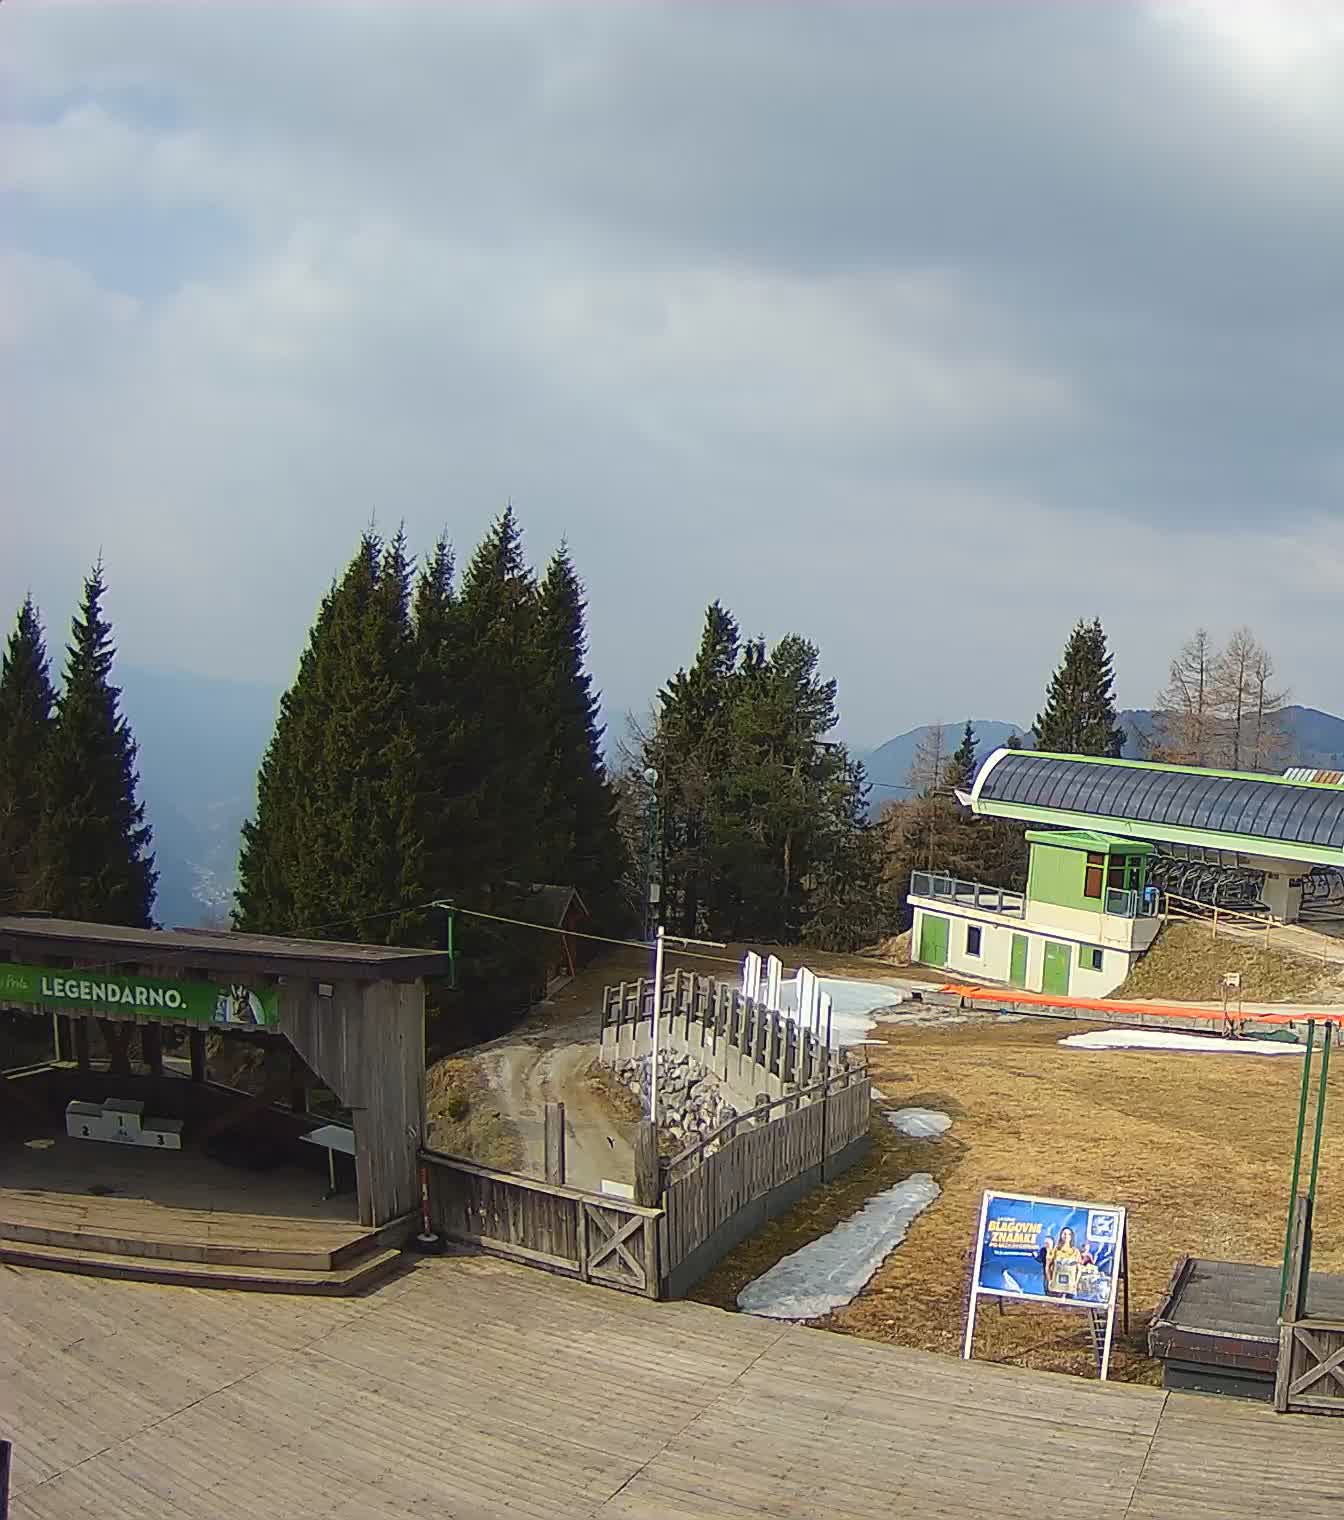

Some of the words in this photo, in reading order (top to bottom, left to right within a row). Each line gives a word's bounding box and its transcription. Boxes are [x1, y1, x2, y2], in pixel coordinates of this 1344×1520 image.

[42, 976, 188, 1009] LEGENDARNO.
[118, 1115, 124, 1127] 1
[82, 1125, 90, 1136] 2
[157, 1134, 165, 1146] 3
